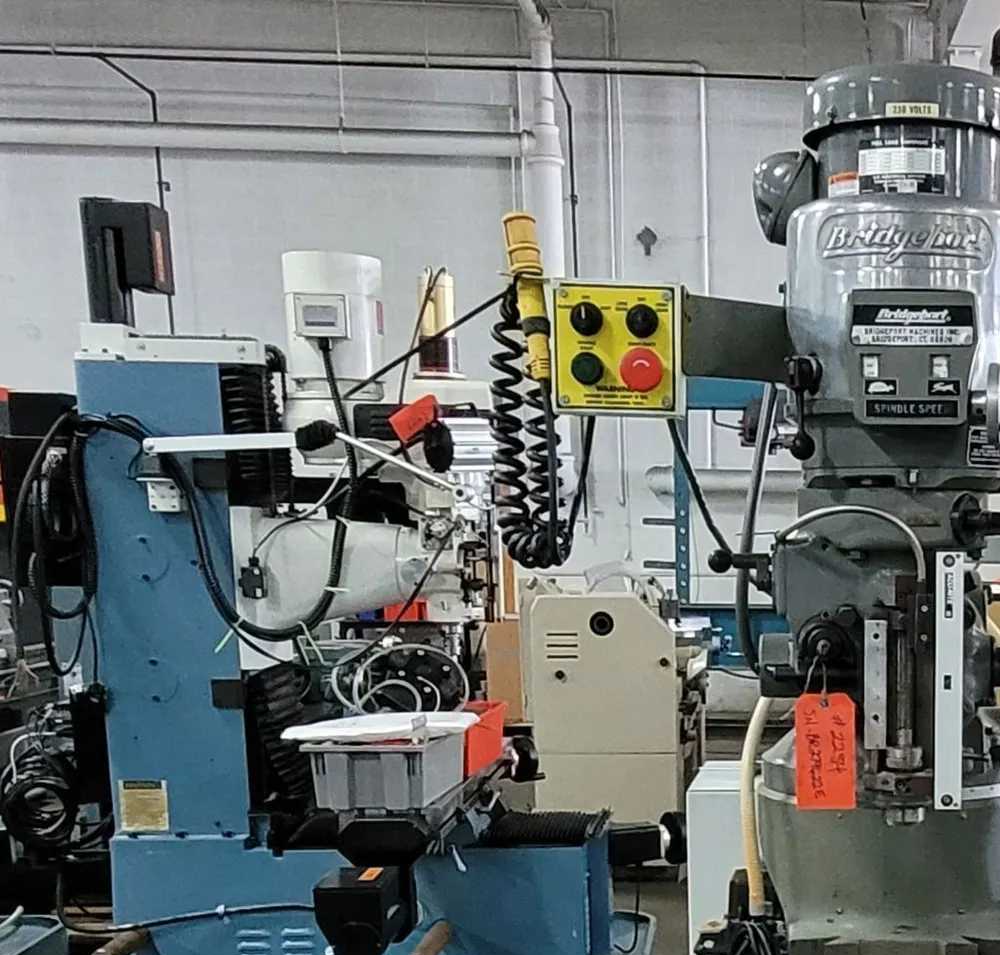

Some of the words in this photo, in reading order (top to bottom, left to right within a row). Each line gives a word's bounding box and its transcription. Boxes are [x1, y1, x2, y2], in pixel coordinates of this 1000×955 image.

[909, 104, 932, 114] VOLTS
[876, 308, 950, 325] Bridgeport
[874, 403, 917, 414] SPINDLE
